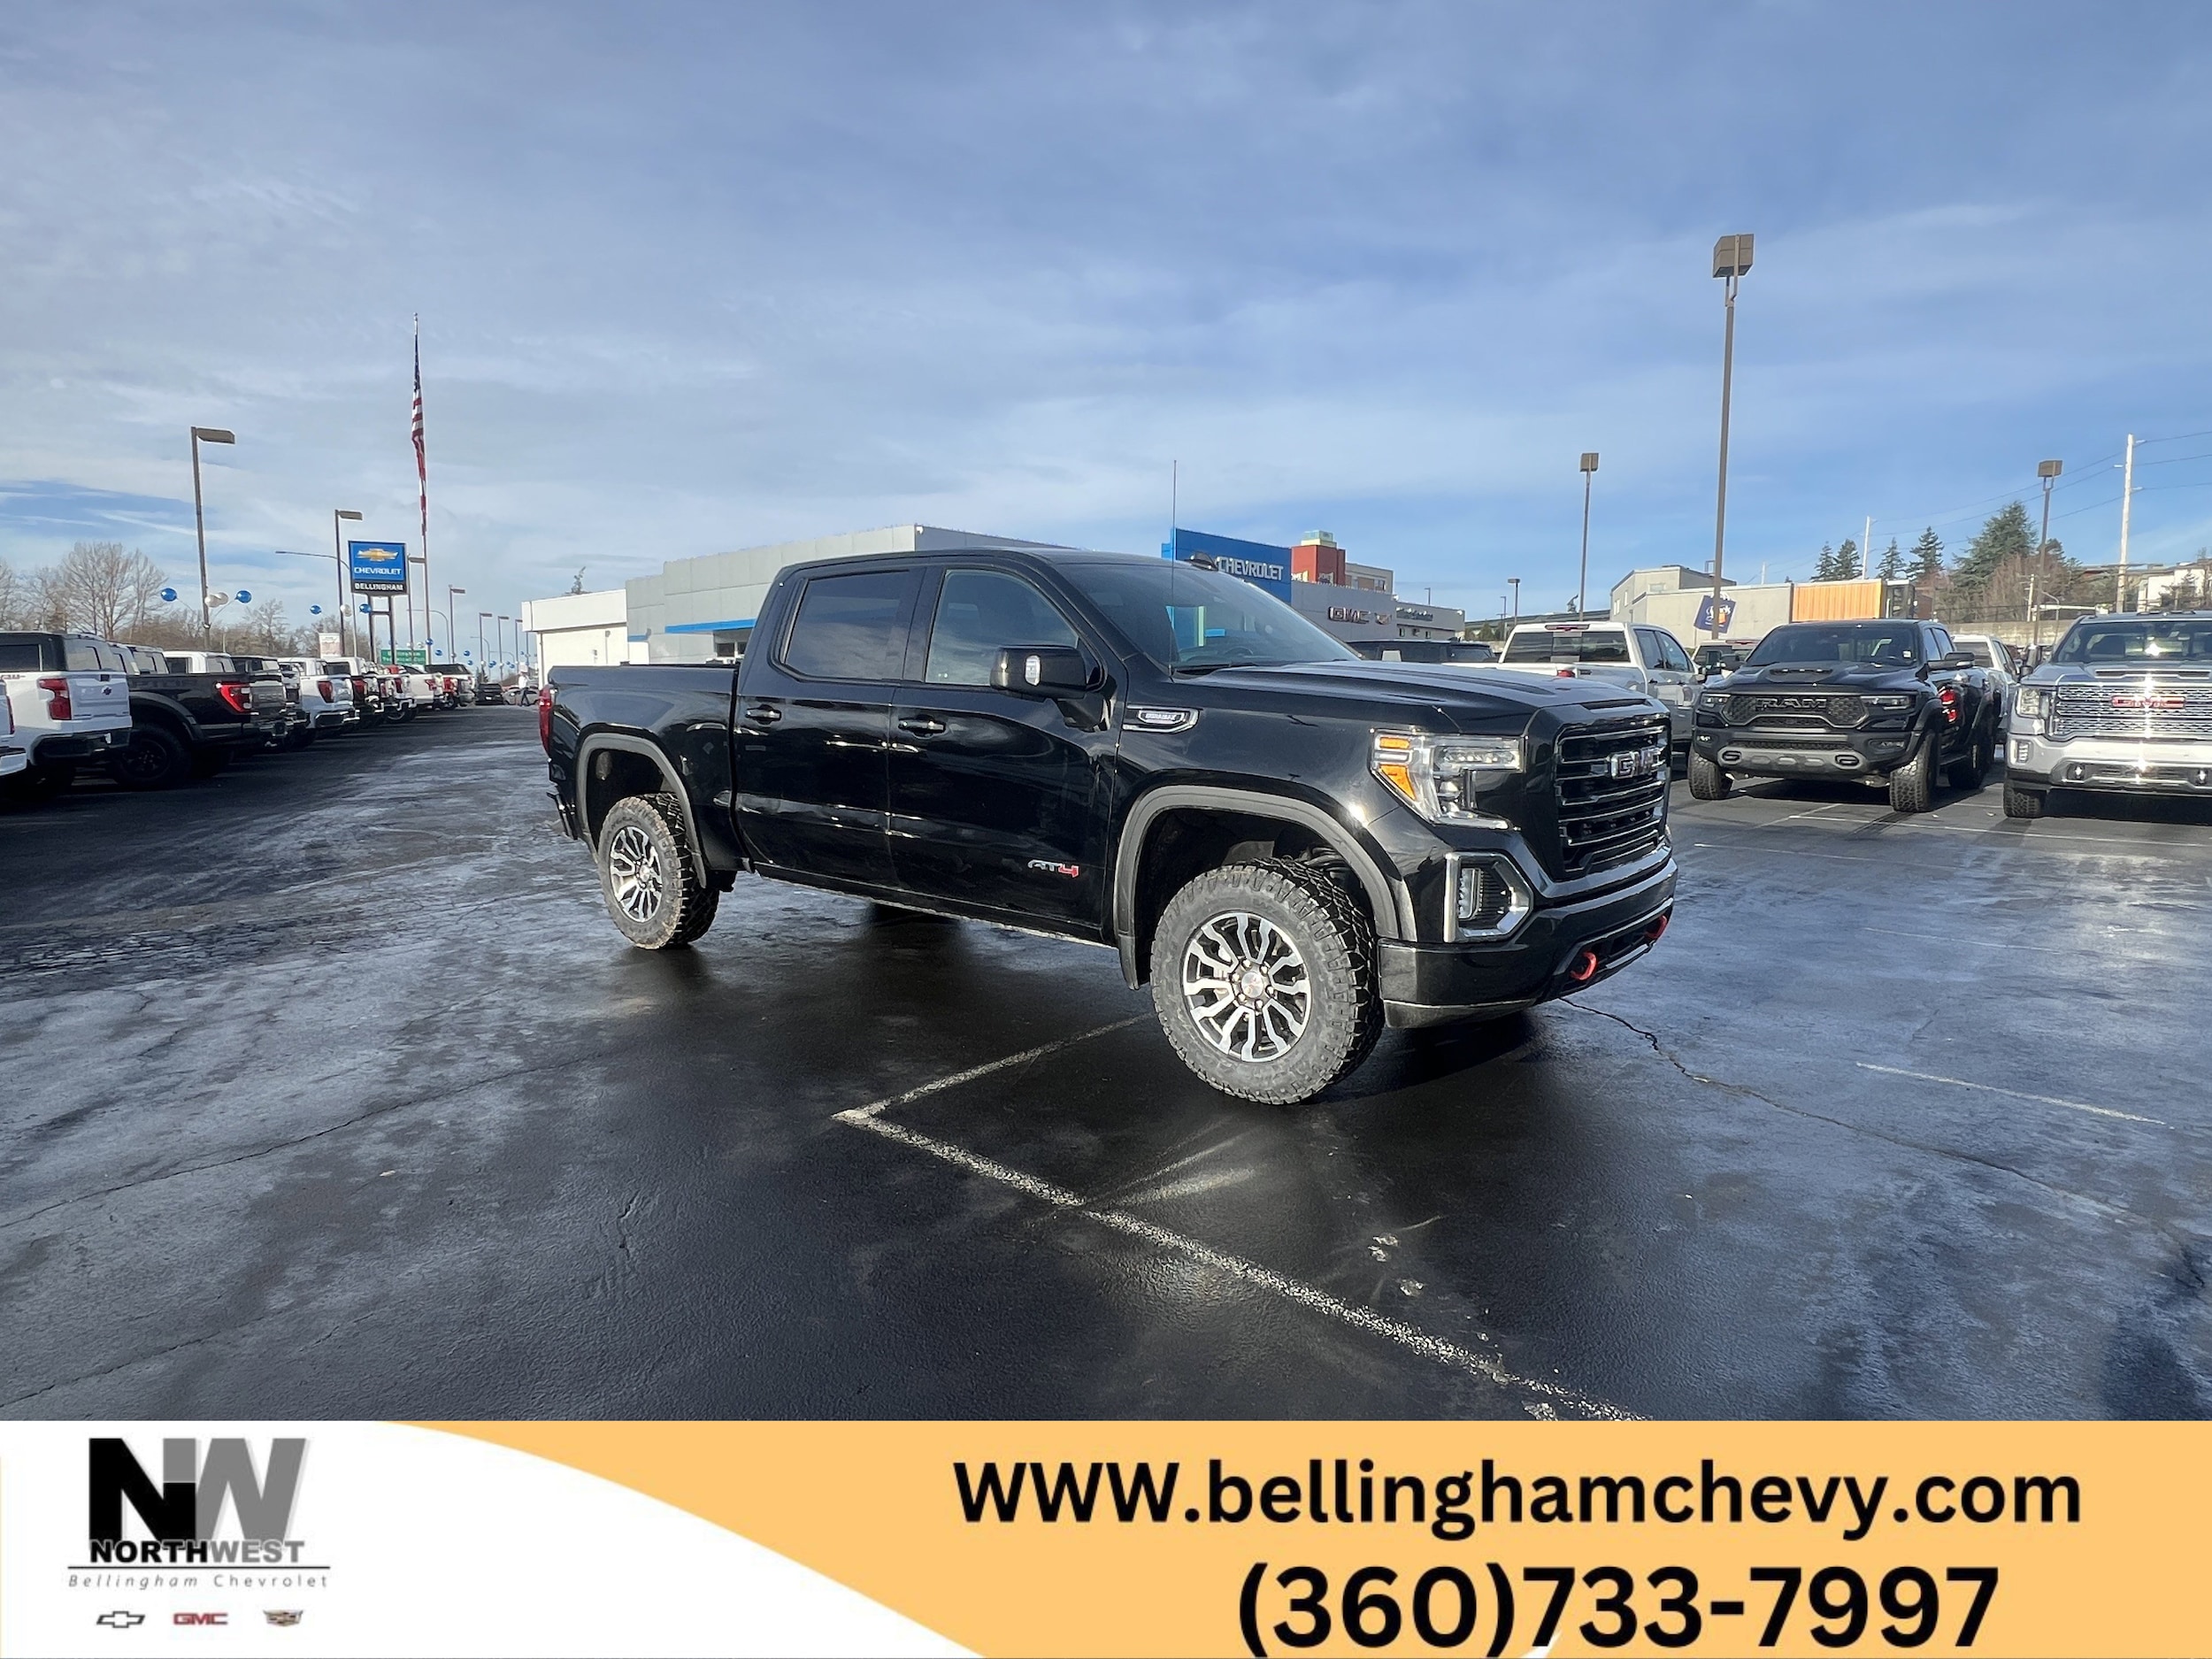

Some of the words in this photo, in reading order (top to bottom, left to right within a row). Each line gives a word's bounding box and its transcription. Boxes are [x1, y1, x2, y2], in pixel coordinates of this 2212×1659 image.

[1217, 557, 1283, 580] CHEVROLET
[354, 582, 403, 591] BELLINGHAM
[1328, 606, 1371, 625] GMC
[1755, 697, 1827, 709] RAM
[2112, 695, 2185, 709] GMC
[1610, 746, 1666, 779] GMC
[1027, 859, 1079, 878] AT4
